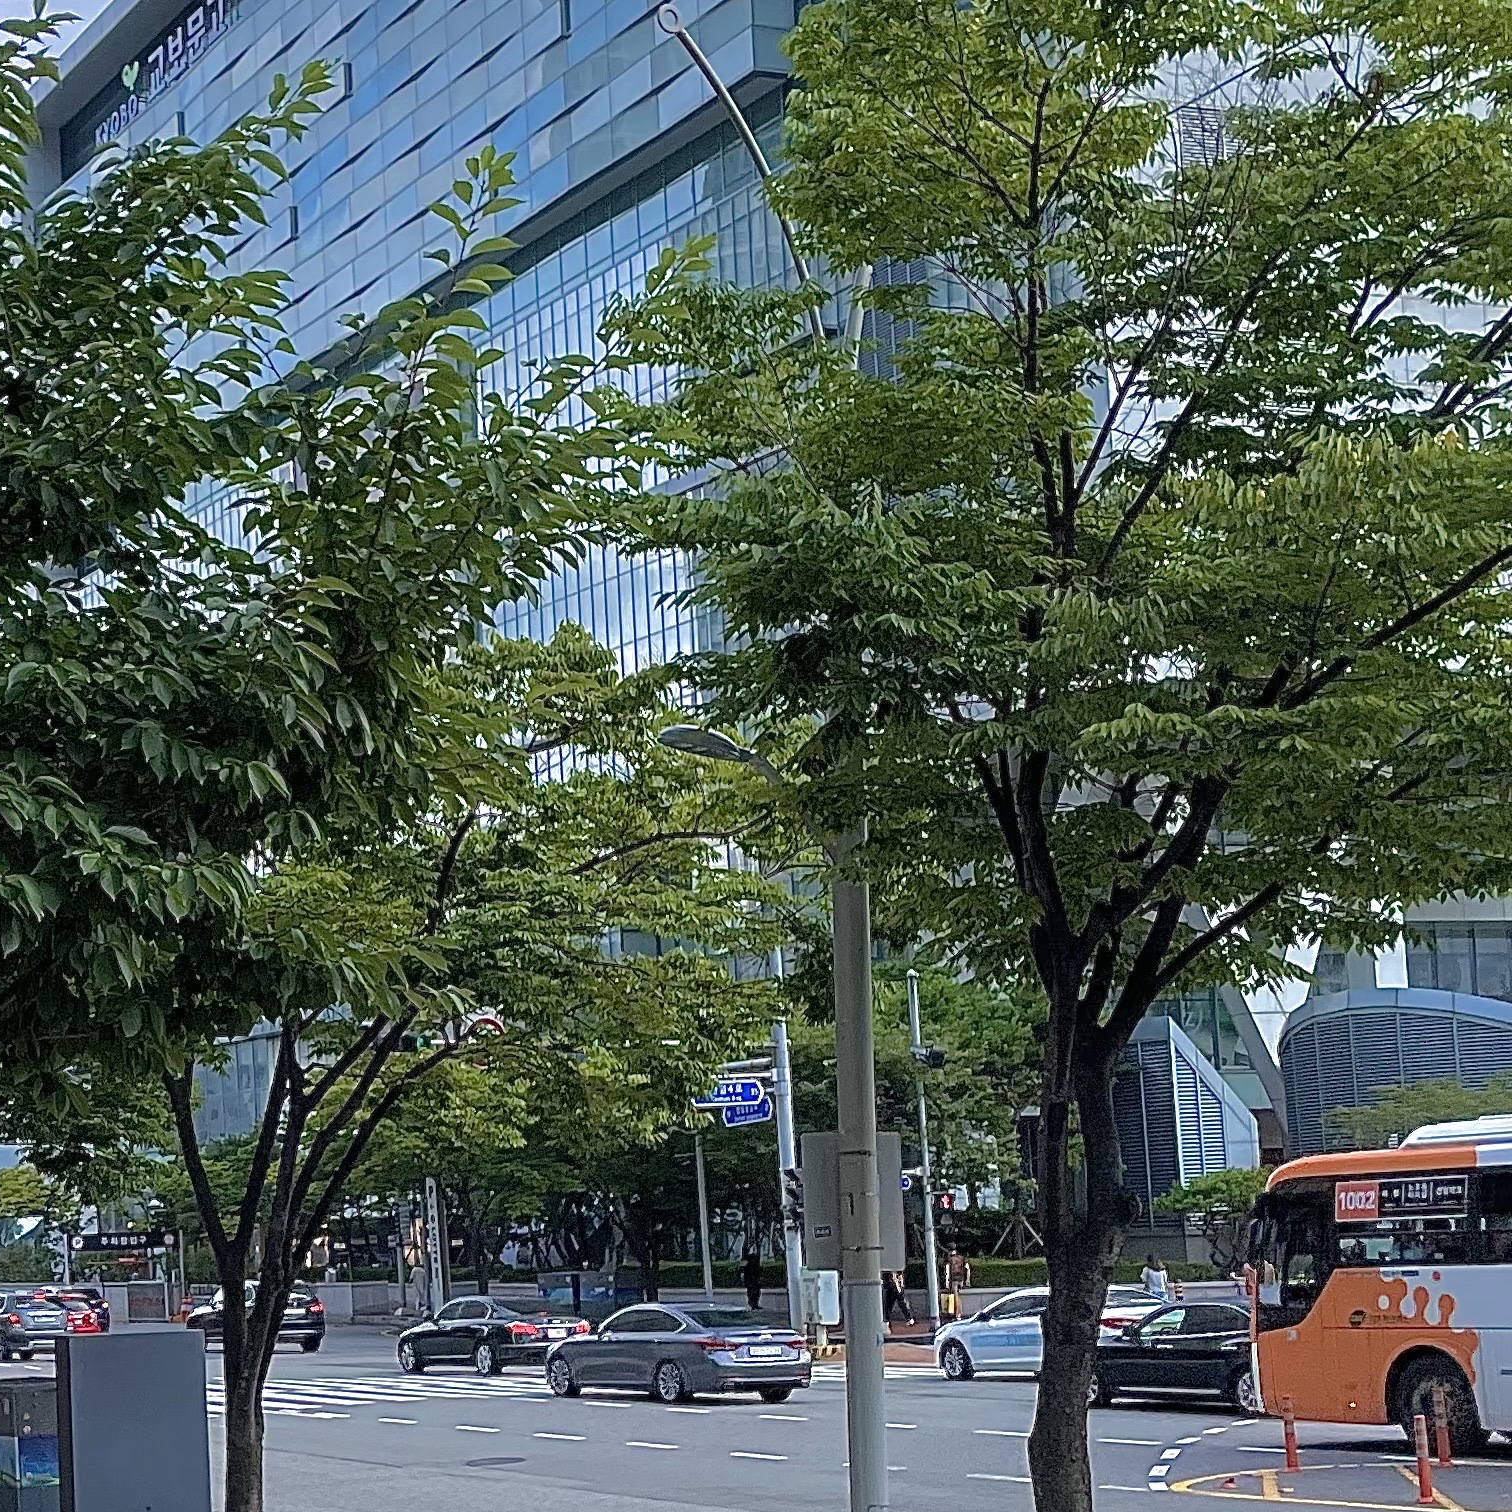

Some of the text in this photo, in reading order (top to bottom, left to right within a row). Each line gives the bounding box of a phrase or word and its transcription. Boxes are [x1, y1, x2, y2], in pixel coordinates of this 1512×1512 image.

[146, 0, 228, 102] 교보문고
[94, 94, 138, 148] KYOBO
[1338, 1190, 1376, 1211] 1002
